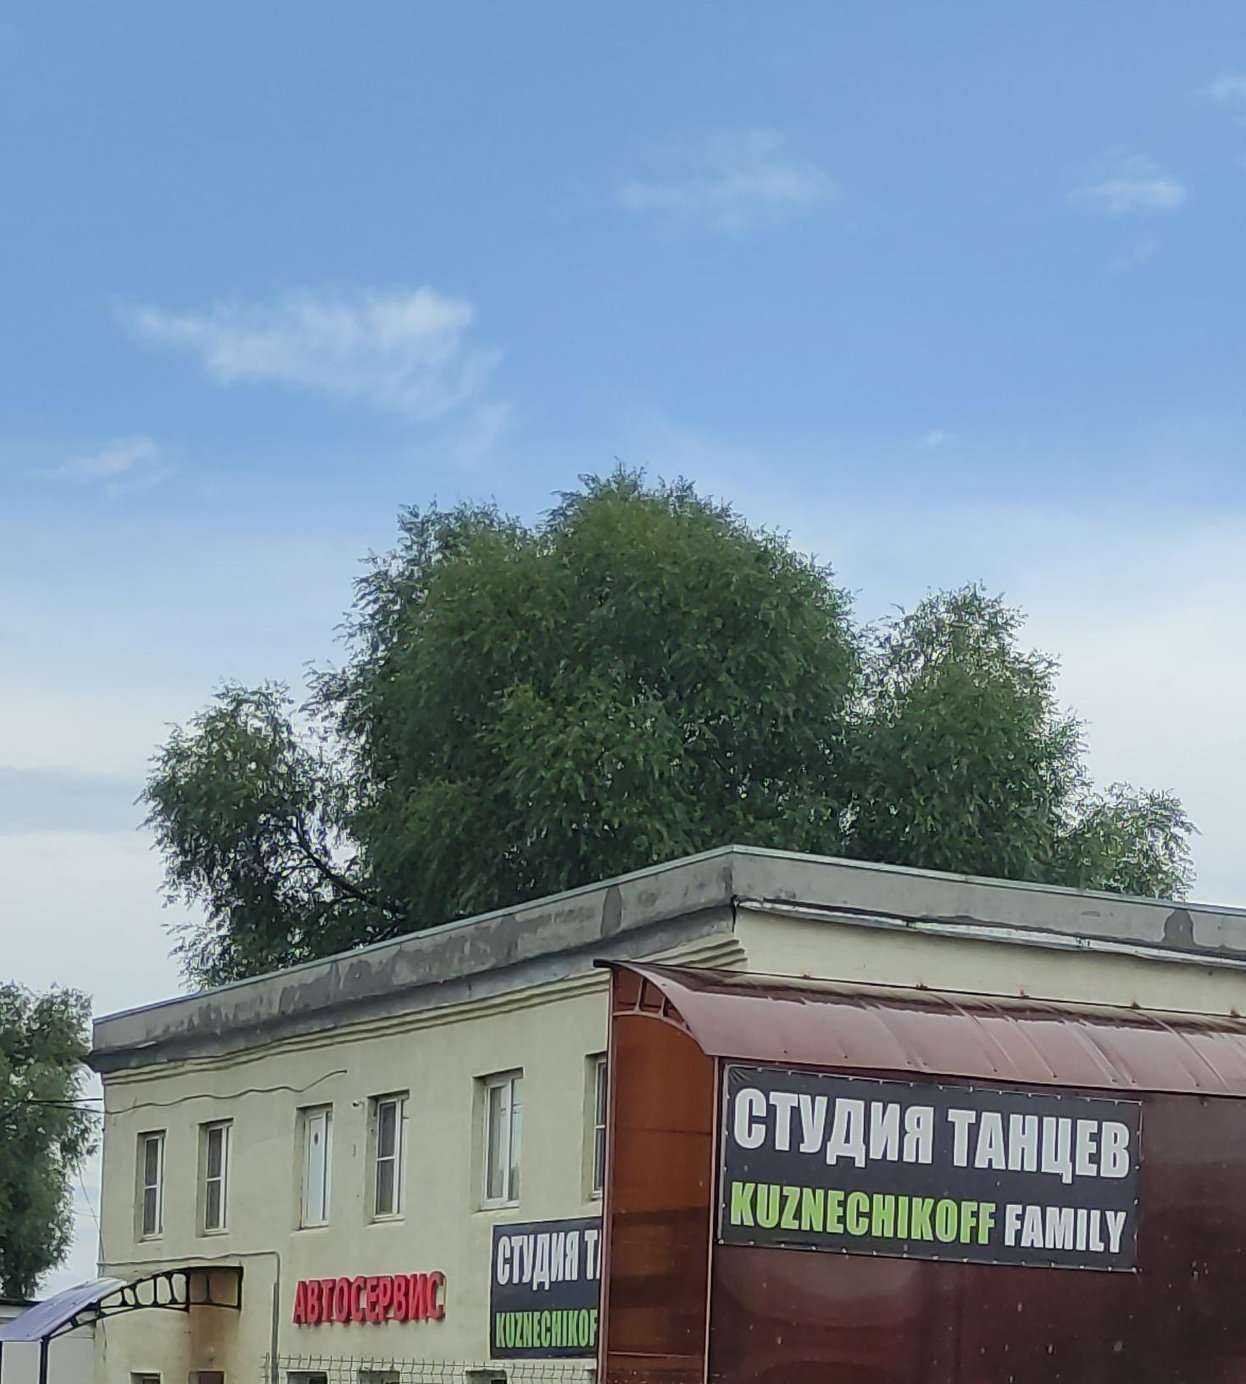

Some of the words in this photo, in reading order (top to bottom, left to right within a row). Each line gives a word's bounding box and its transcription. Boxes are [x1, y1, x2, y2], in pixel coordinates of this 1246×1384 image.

[734, 1088, 934, 1168] СТУДИЯ
[947, 1108, 1131, 1184] ТАНЦЕВ
[730, 1181, 996, 1245] KUZNECHIKOFF
[1004, 1204, 1127, 1254] FAMILY
[497, 1230, 580, 1291] СТУДИЯ
[584, 1229, 602, 1280] Т
[293, 1271, 446, 1324] АВТОСЕРВИС
